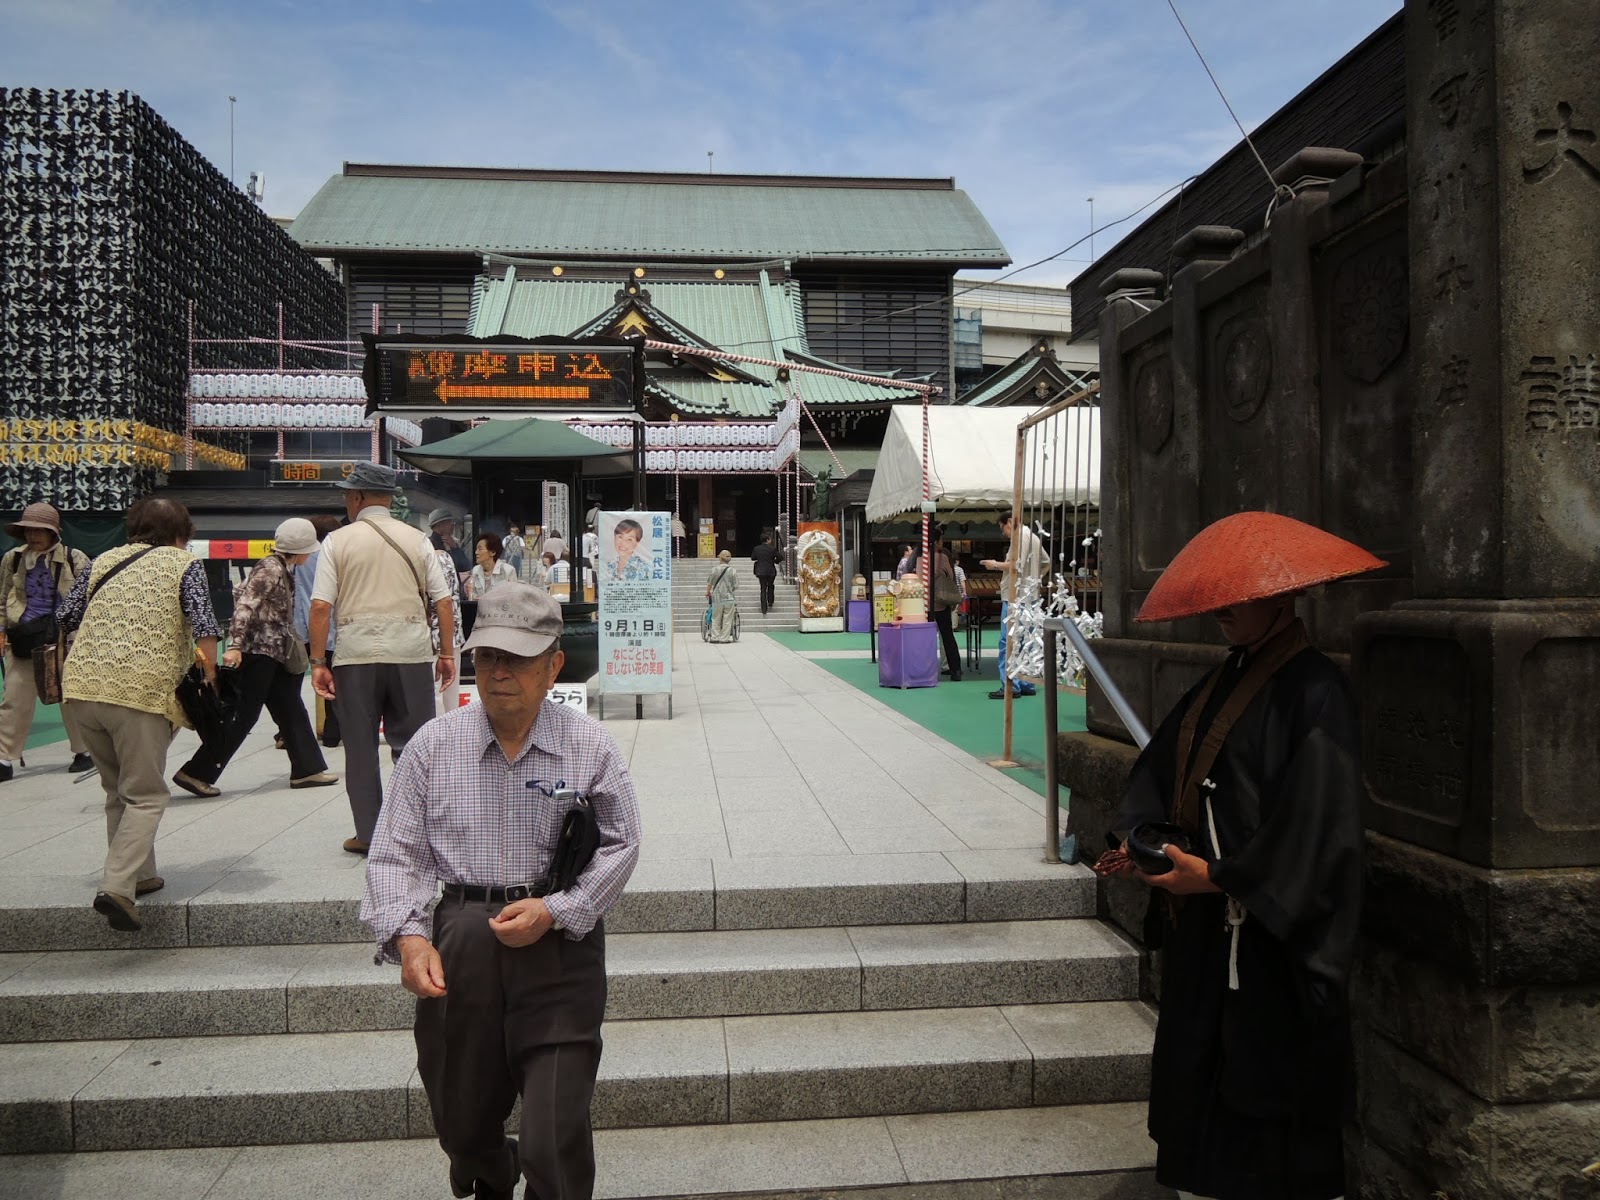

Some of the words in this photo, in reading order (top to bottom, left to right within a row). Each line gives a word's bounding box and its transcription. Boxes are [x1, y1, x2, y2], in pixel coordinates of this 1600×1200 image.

[283, 462, 321, 481] 時間
[652, 549, 663, 580] 一代氏
[613, 647, 657, 661] なにごとにも
